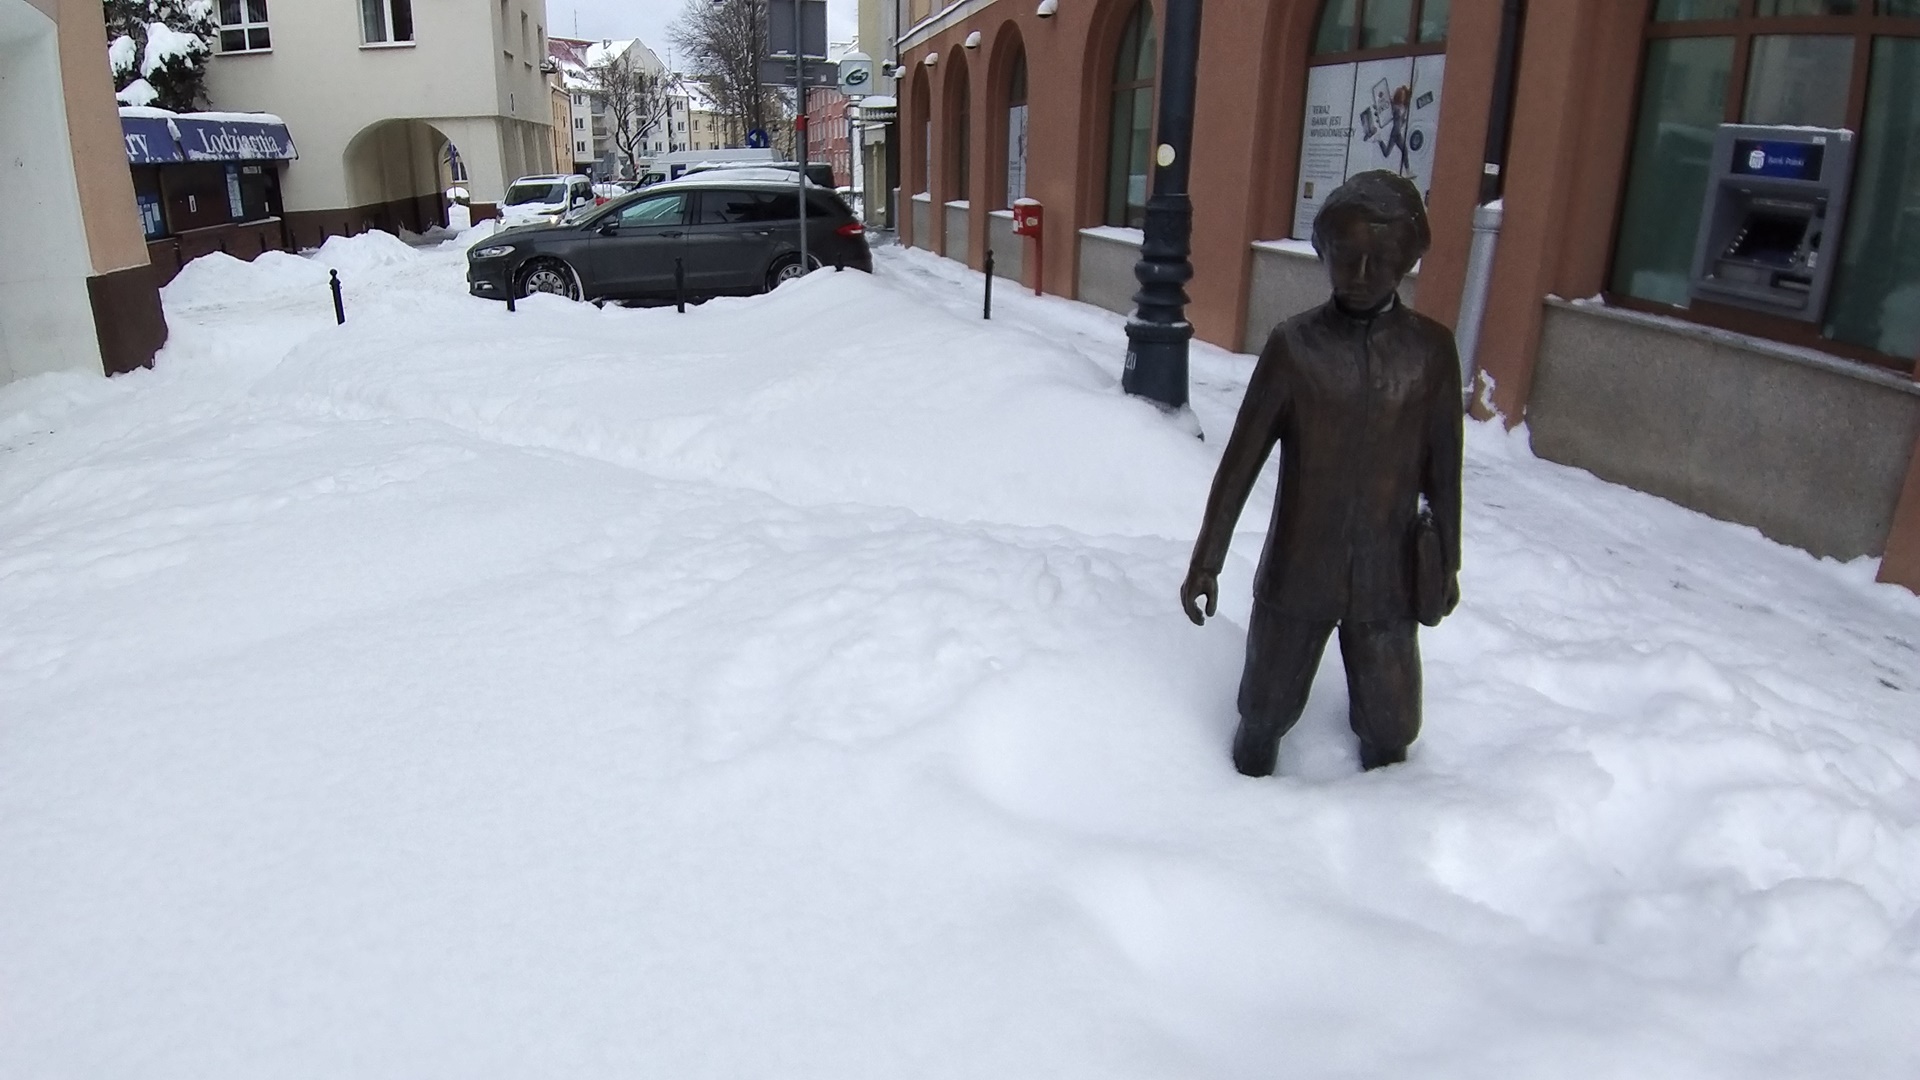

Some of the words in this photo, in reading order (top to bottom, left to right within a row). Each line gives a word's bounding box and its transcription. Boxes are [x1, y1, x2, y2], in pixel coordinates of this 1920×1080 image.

[1311, 116, 1328, 126] BANK
[1329, 115, 1342, 126] JEST
[197, 126, 281, 154] Lodziarnia
